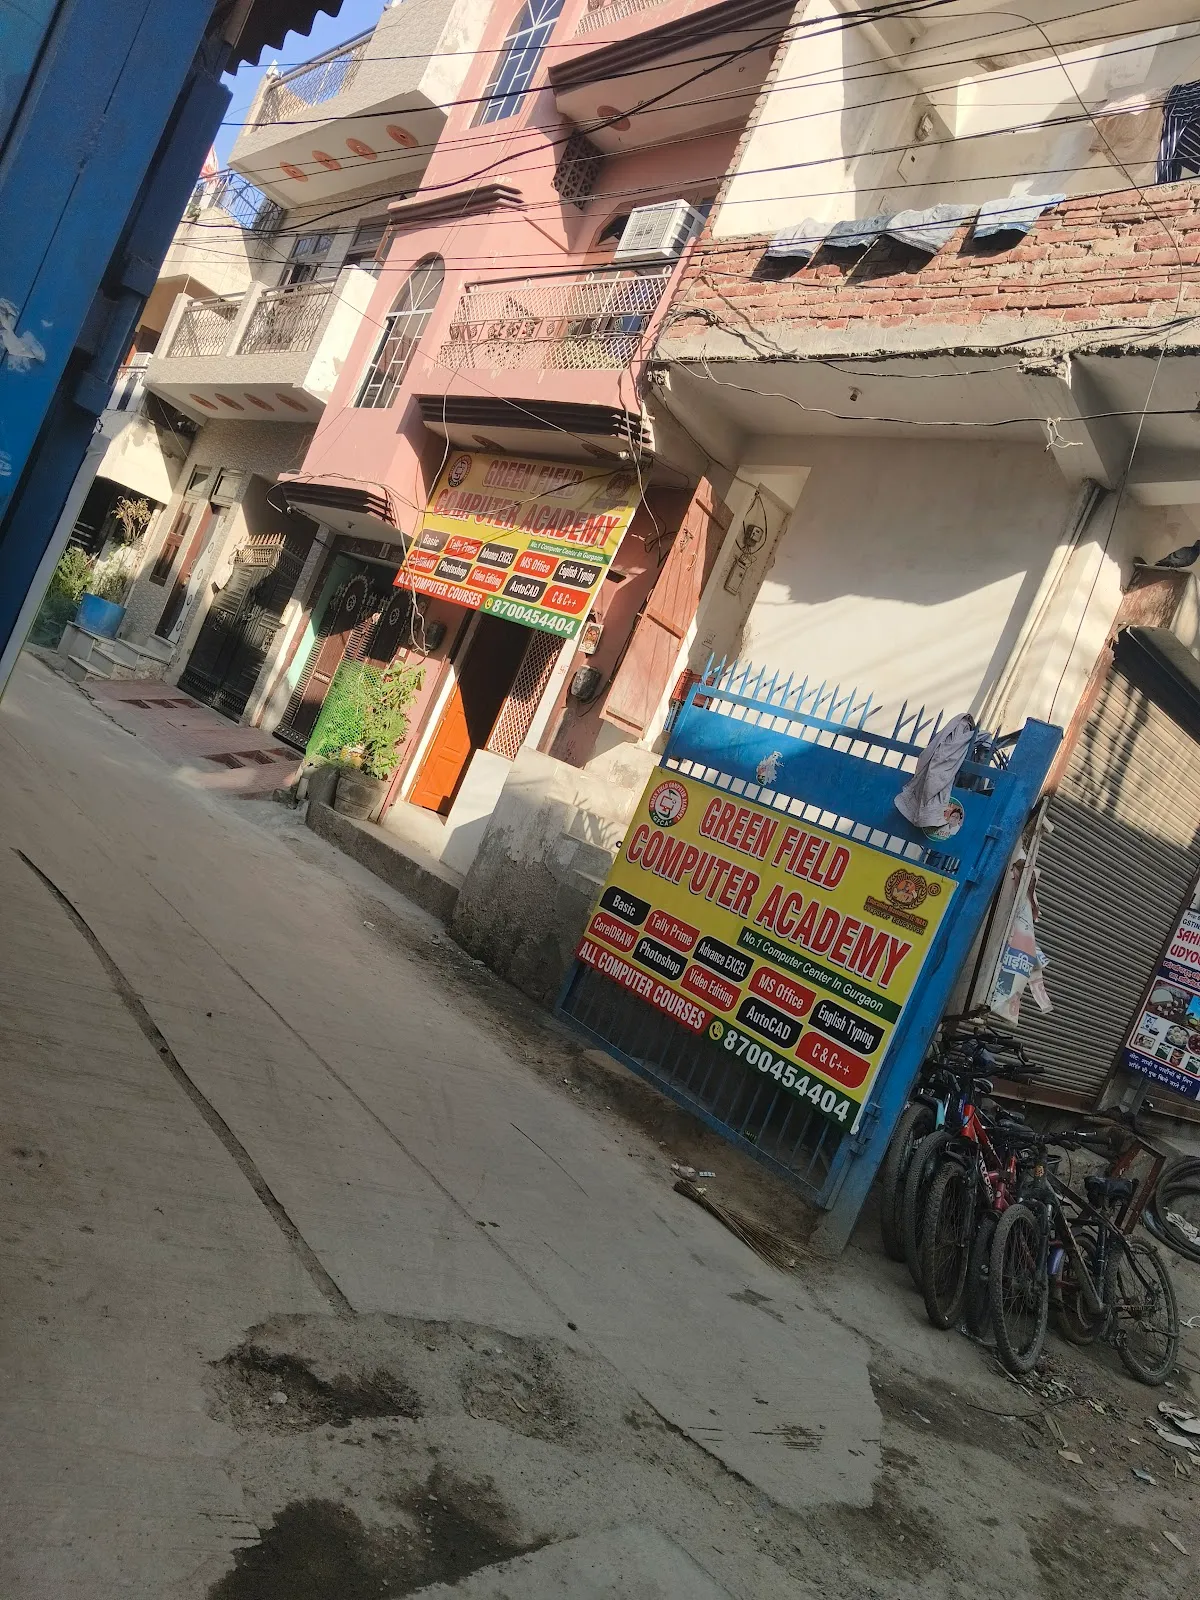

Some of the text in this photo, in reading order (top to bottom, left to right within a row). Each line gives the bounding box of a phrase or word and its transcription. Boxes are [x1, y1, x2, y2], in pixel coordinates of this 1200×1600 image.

[483, 459, 537, 492] GREEN
[530, 463, 585, 500] FIELD
[433, 487, 621, 549] COMPUTER ACADEMY
[423, 533, 440, 547] Basic
[448, 538, 478, 555] Tally Prime
[481, 547, 513, 565] Advance EXCEL
[540, 543, 562, 555] Computer
[561, 546, 577, 557] Center
[582, 552, 604, 563] Gurgaon
[438, 560, 468, 579] Photoshop
[471, 569, 503, 589] Video Editing
[519, 556, 551, 574] MS Office
[558, 564, 596, 586] English Typing
[397, 573, 483, 606] ALL COMPUTER COURSES
[508, 580, 540, 598] AutoCAD
[551, 590, 558, 601] C
[562, 594, 577, 607] C++
[491, 599, 576, 635] 8700454404
[699, 796, 852, 892] GREEN FIELD
[612, 894, 636, 917] Basic
[626, 823, 915, 990] COMPUTER ACADEMY
[593, 917, 635, 948] CorelDRAW
[651, 913, 693, 947] Tally Prime
[639, 940, 681, 976] Photoshop
[698, 941, 747, 978] Advance EXCEL
[743, 932, 884, 1012] No.1 Computer Center In Gurgaon
[579, 941, 706, 1030] ALL COMPUTER COURSES
[688, 968, 734, 1008] Video Editing
[757, 973, 805, 1010] MS Office
[746, 1005, 792, 1041] AutoCAD
[818, 1003, 875, 1050] English Typing
[722, 1029, 852, 1122] 8700454404
[811, 1042, 851, 1076] C & C++
